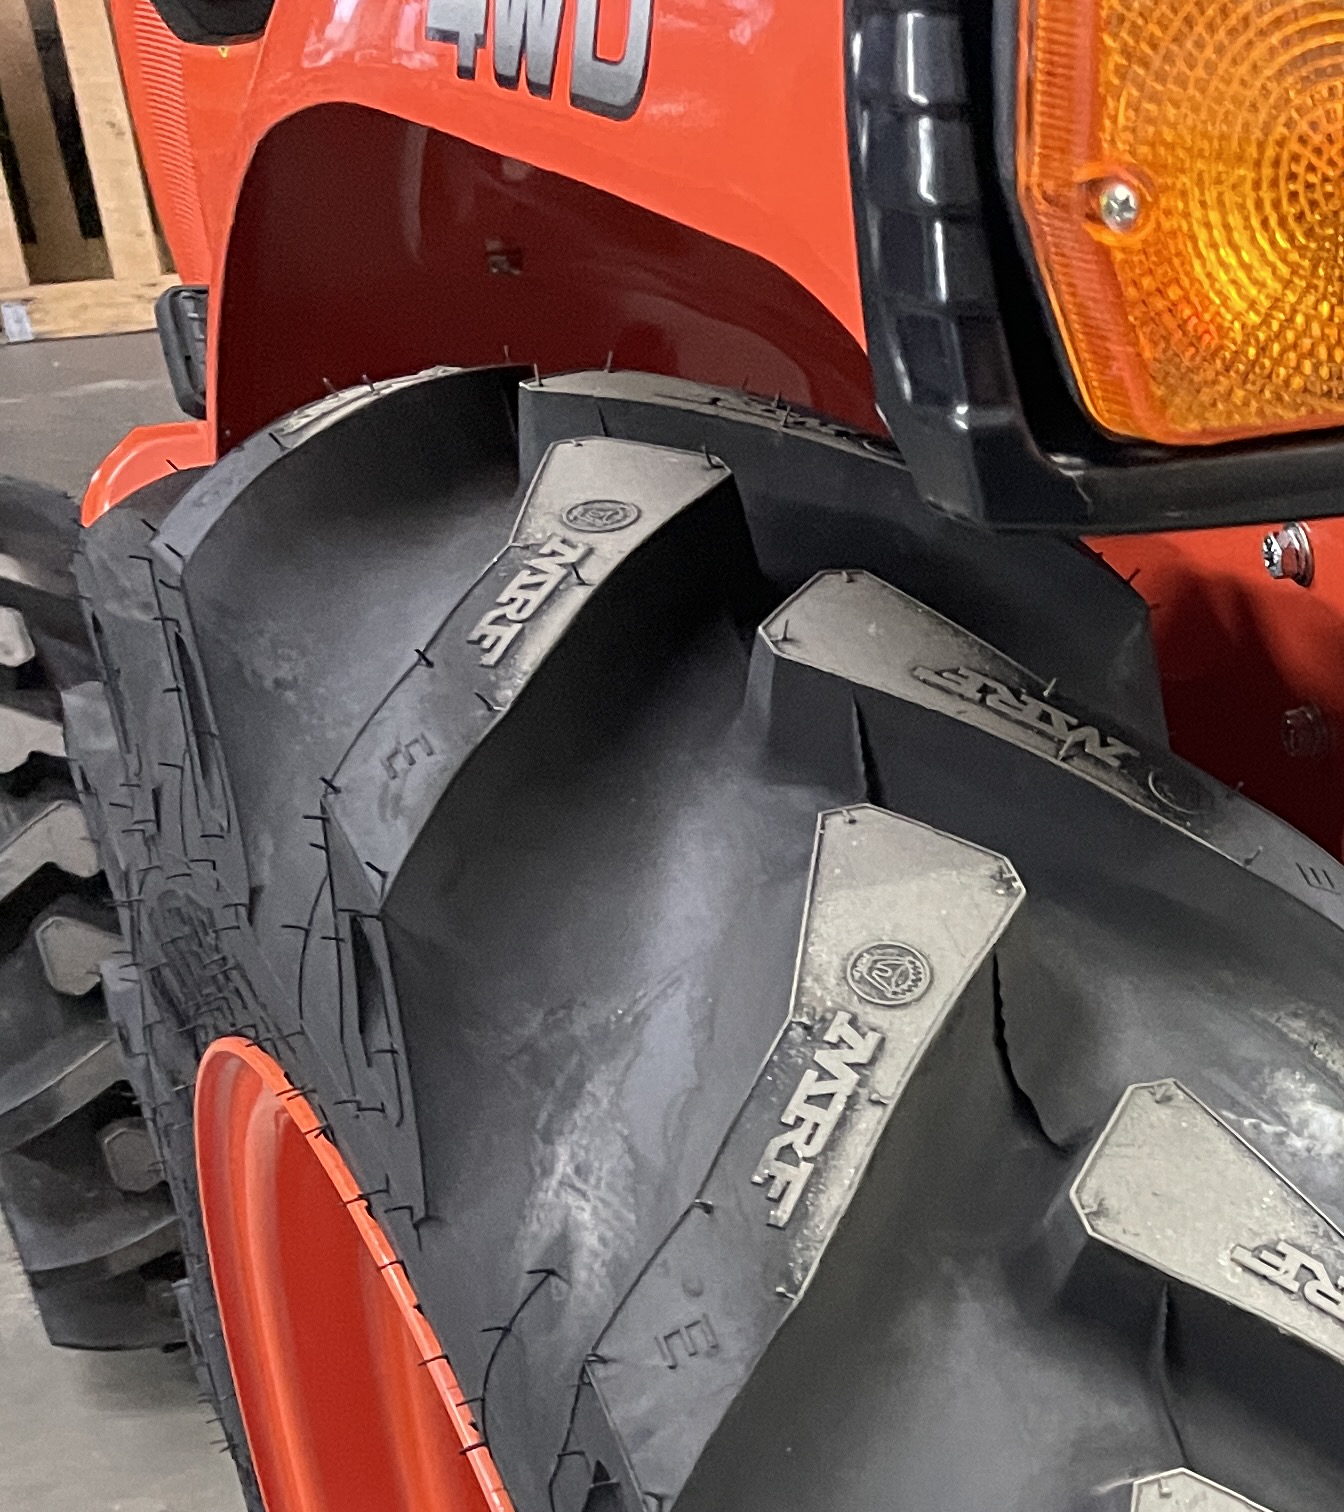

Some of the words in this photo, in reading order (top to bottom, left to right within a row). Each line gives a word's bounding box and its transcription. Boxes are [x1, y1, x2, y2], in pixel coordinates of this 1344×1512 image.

[466, 534, 593, 669] MRF
[911, 665, 1141, 768] MRF
[751, 1009, 885, 1230] MRF
